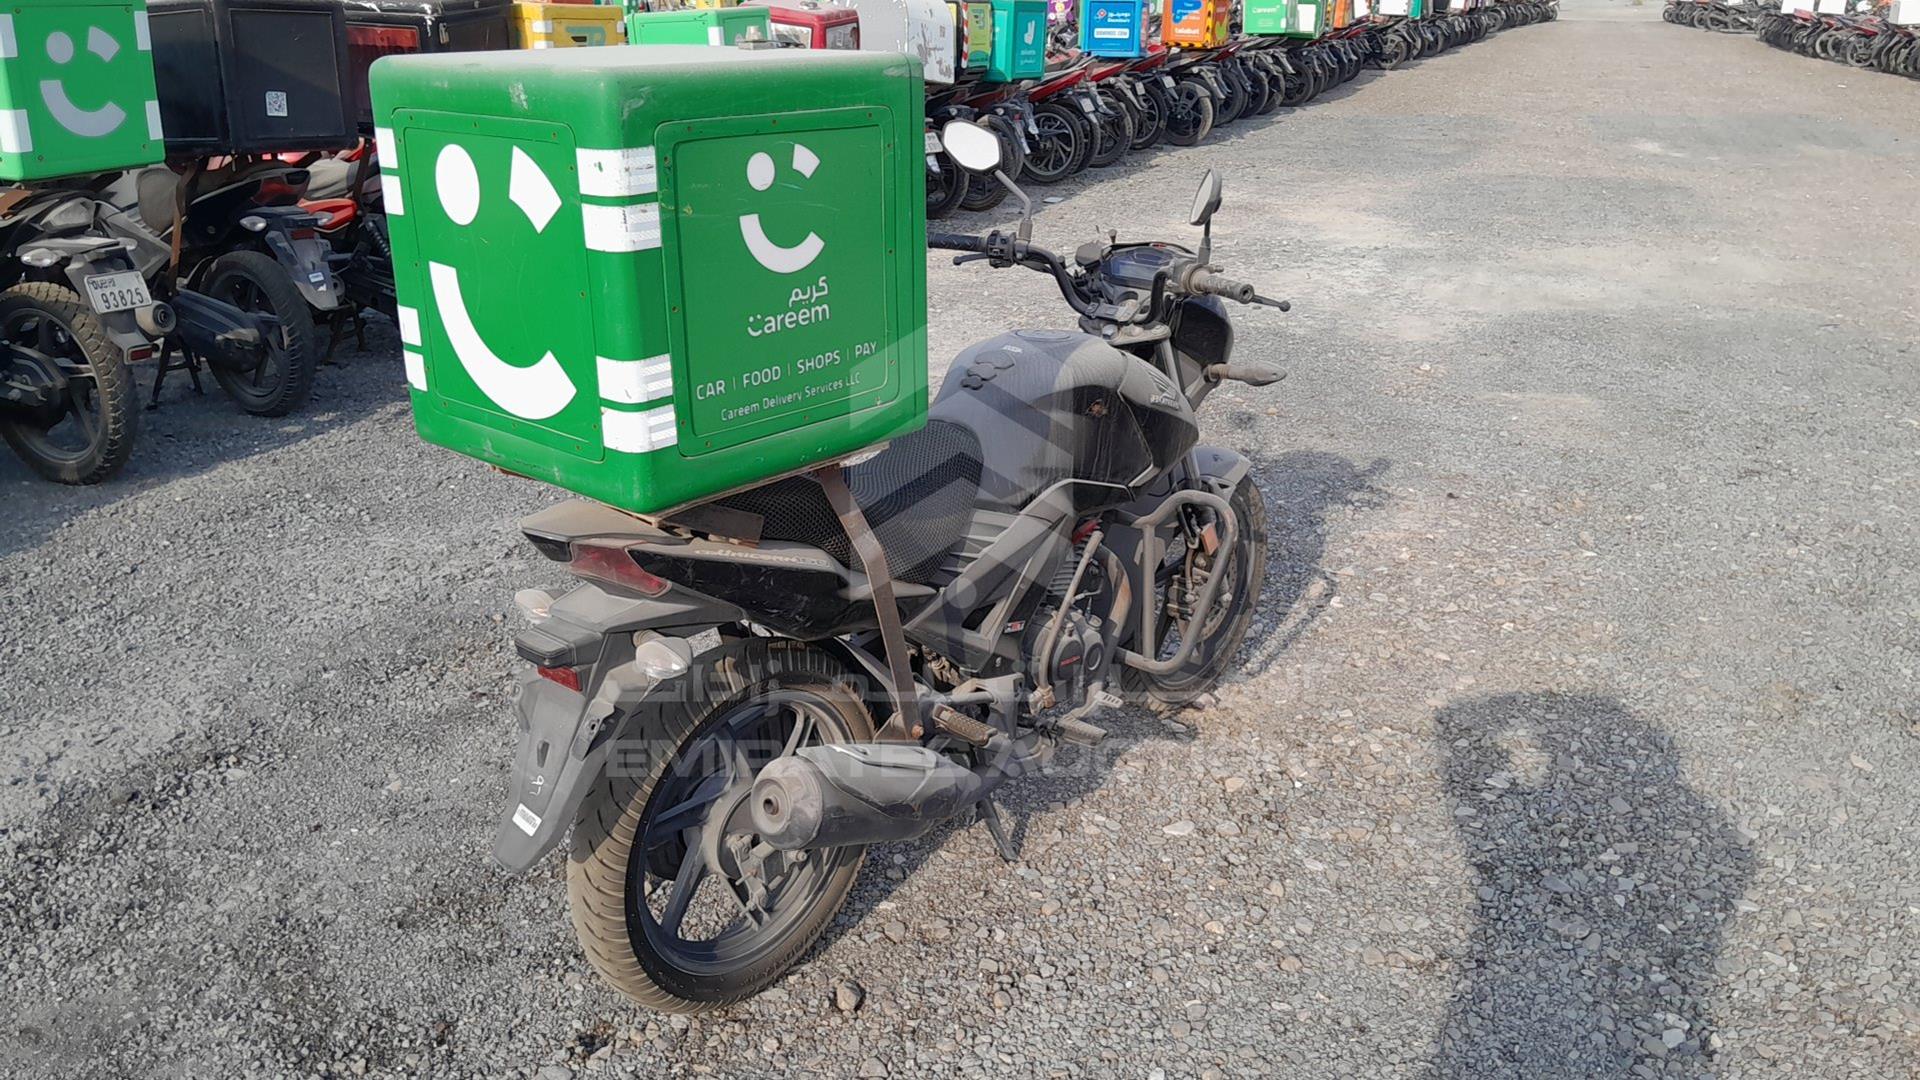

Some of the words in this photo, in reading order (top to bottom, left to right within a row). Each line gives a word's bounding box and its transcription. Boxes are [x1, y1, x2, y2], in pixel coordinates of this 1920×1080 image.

[101, 287, 144, 310] 93825
[789, 275, 829, 308] كريم
[747, 303, 830, 337] Careem
[696, 379, 727, 401] CAR
[742, 365, 782, 389] FOOD
[796, 350, 841, 375] SHOPS
[855, 341, 878, 359] PAY
[721, 402, 760, 422] Careem
[762, 391, 803, 409] Delivery
[804, 378, 843, 398] Services
[845, 371, 861, 387] LLC
